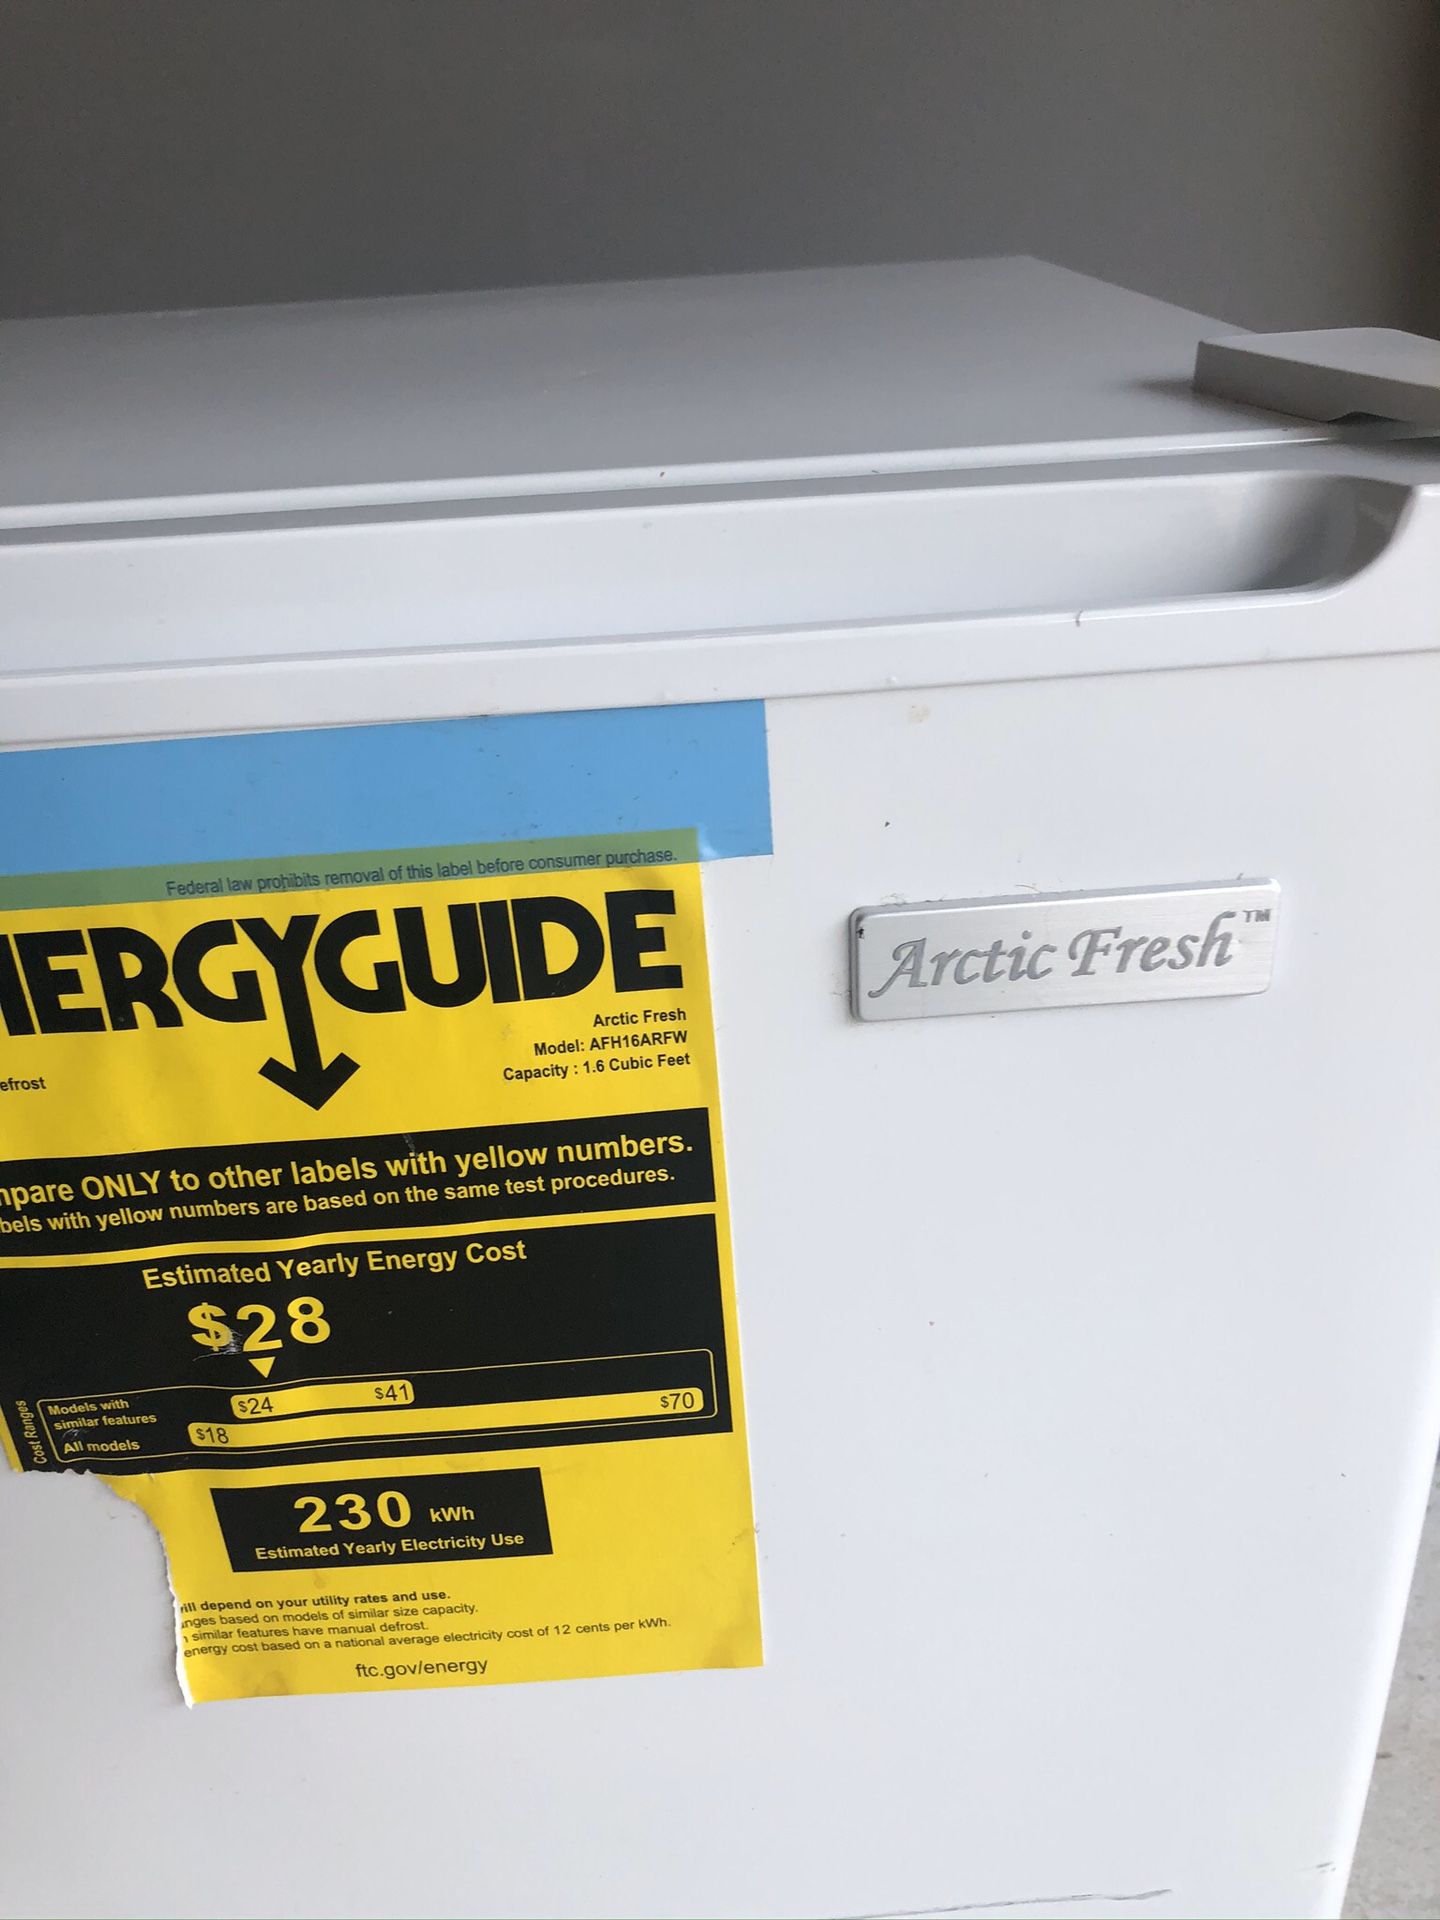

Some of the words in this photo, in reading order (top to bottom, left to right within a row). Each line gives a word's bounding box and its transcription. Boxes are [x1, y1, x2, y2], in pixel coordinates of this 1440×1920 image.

[166, 878, 223, 896] Federal
[228, 876, 253, 892] law
[257, 872, 320, 893] prohibits
[325, 867, 384, 886] removal
[389, 865, 404, 881] of
[406, 862, 433, 880] this
[437, 861, 473, 877] label
[477, 857, 525, 875] before
[529, 853, 602, 871] consumer
[606, 848, 678, 868] purchase.
[868, 930, 1058, 999] Arctic
[1069, 910, 1236, 977] Fresh
[593, 1012, 639, 1027] Arctic
[643, 1008, 687, 1023] Fresh
[534, 1039, 585, 1056] Model:
[589, 1030, 688, 1051] AFH16ARFW
[503, 1064, 569, 1082] Capacity
[583, 1059, 605, 1074] 1.6
[609, 1055, 653, 1071] Cubic
[657, 1052, 691, 1067] Feet
[0, 1077, 47, 1091] efrost
[81, 1170, 161, 1201] ONLY
[170, 1169, 200, 1192] to
[209, 1164, 283, 1190] other
[291, 1157, 378, 1185] labels
[385, 1150, 447, 1178] with
[454, 1145, 548, 1178] yellow
[557, 1134, 693, 1163] numbers.
[47, 1211, 91, 1231] with
[96, 1206, 163, 1232] yellow
[169, 1198, 260, 1220] numbers
[266, 1200, 298, 1216] are
[303, 1190, 368, 1212] based
[374, 1190, 400, 1206] on
[405, 1185, 439, 1203] the
[443, 1182, 500, 1201] same
[504, 1176, 546, 1195] test
[551, 1167, 675, 1195] procedures.
[142, 1262, 272, 1290] Estimated
[276, 1252, 359, 1282] Yearly
[367, 1248, 458, 1273] Energy
[465, 1239, 528, 1264] Cost
[188, 1295, 331, 1352] $28
[374, 1383, 410, 1402] $41
[660, 1391, 695, 1411] $70
[47, 1402, 98, 1416] Models
[100, 1399, 130, 1411] with
[238, 1397, 274, 1414] $24
[15, 1400, 39, 1439] Ranges
[53, 1417, 99, 1430] similar
[102, 1414, 157, 1426] features
[64, 1440, 84, 1454] All
[86, 1439, 141, 1452] models
[196, 1426, 230, 1444] $18
[29, 1441, 47, 1464] Cost
[293, 1490, 412, 1533] 230
[429, 1505, 475, 1523] kWh
[255, 1544, 340, 1560] Estimated
[343, 1540, 396, 1556] Yearly
[401, 1535, 487, 1552] Electricity
[491, 1533, 525, 1546] Use
[200, 1599, 252, 1612] depend
[255, 1599, 273, 1609] on
[277, 1598, 308, 1610] your
[312, 1595, 350, 1608] utility
[354, 1593, 388, 1605] rates
[392, 1590, 418, 1602] and
[421, 1590, 451, 1601] use.
[220, 1613, 259, 1625] based
[263, 1613, 279, 1623] on
[282, 1610, 329, 1622] models
[332, 1609, 345, 1620] of
[347, 1608, 389, 1620] similar
[393, 1606, 419, 1617] size
[422, 1603, 478, 1617] capacity.
[184, 1645, 228, 1658] energy
[231, 1642, 259, 1652] cost
[261, 1640, 301, 1651] based
[304, 1639, 320, 1649] on
[323, 1639, 332, 1649] a
[335, 1635, 385, 1648] national
[388, 1634, 440, 1648] average
[443, 1629, 503, 1643] electricity
[506, 1627, 533, 1638] cost
[537, 1625, 549, 1637] of
[554, 1625, 571, 1635] 12
[576, 1621, 610, 1634] cents
[614, 1621, 634, 1633] per
[638, 1617, 671, 1629] kWh.
[192, 1629, 233, 1641] similar
[237, 1627, 290, 1639] features
[292, 1624, 324, 1637] have
[328, 1622, 376, 1635] manual
[380, 1620, 429, 1633] defrost.
[355, 1657, 488, 1680] ftc.gov/energy
